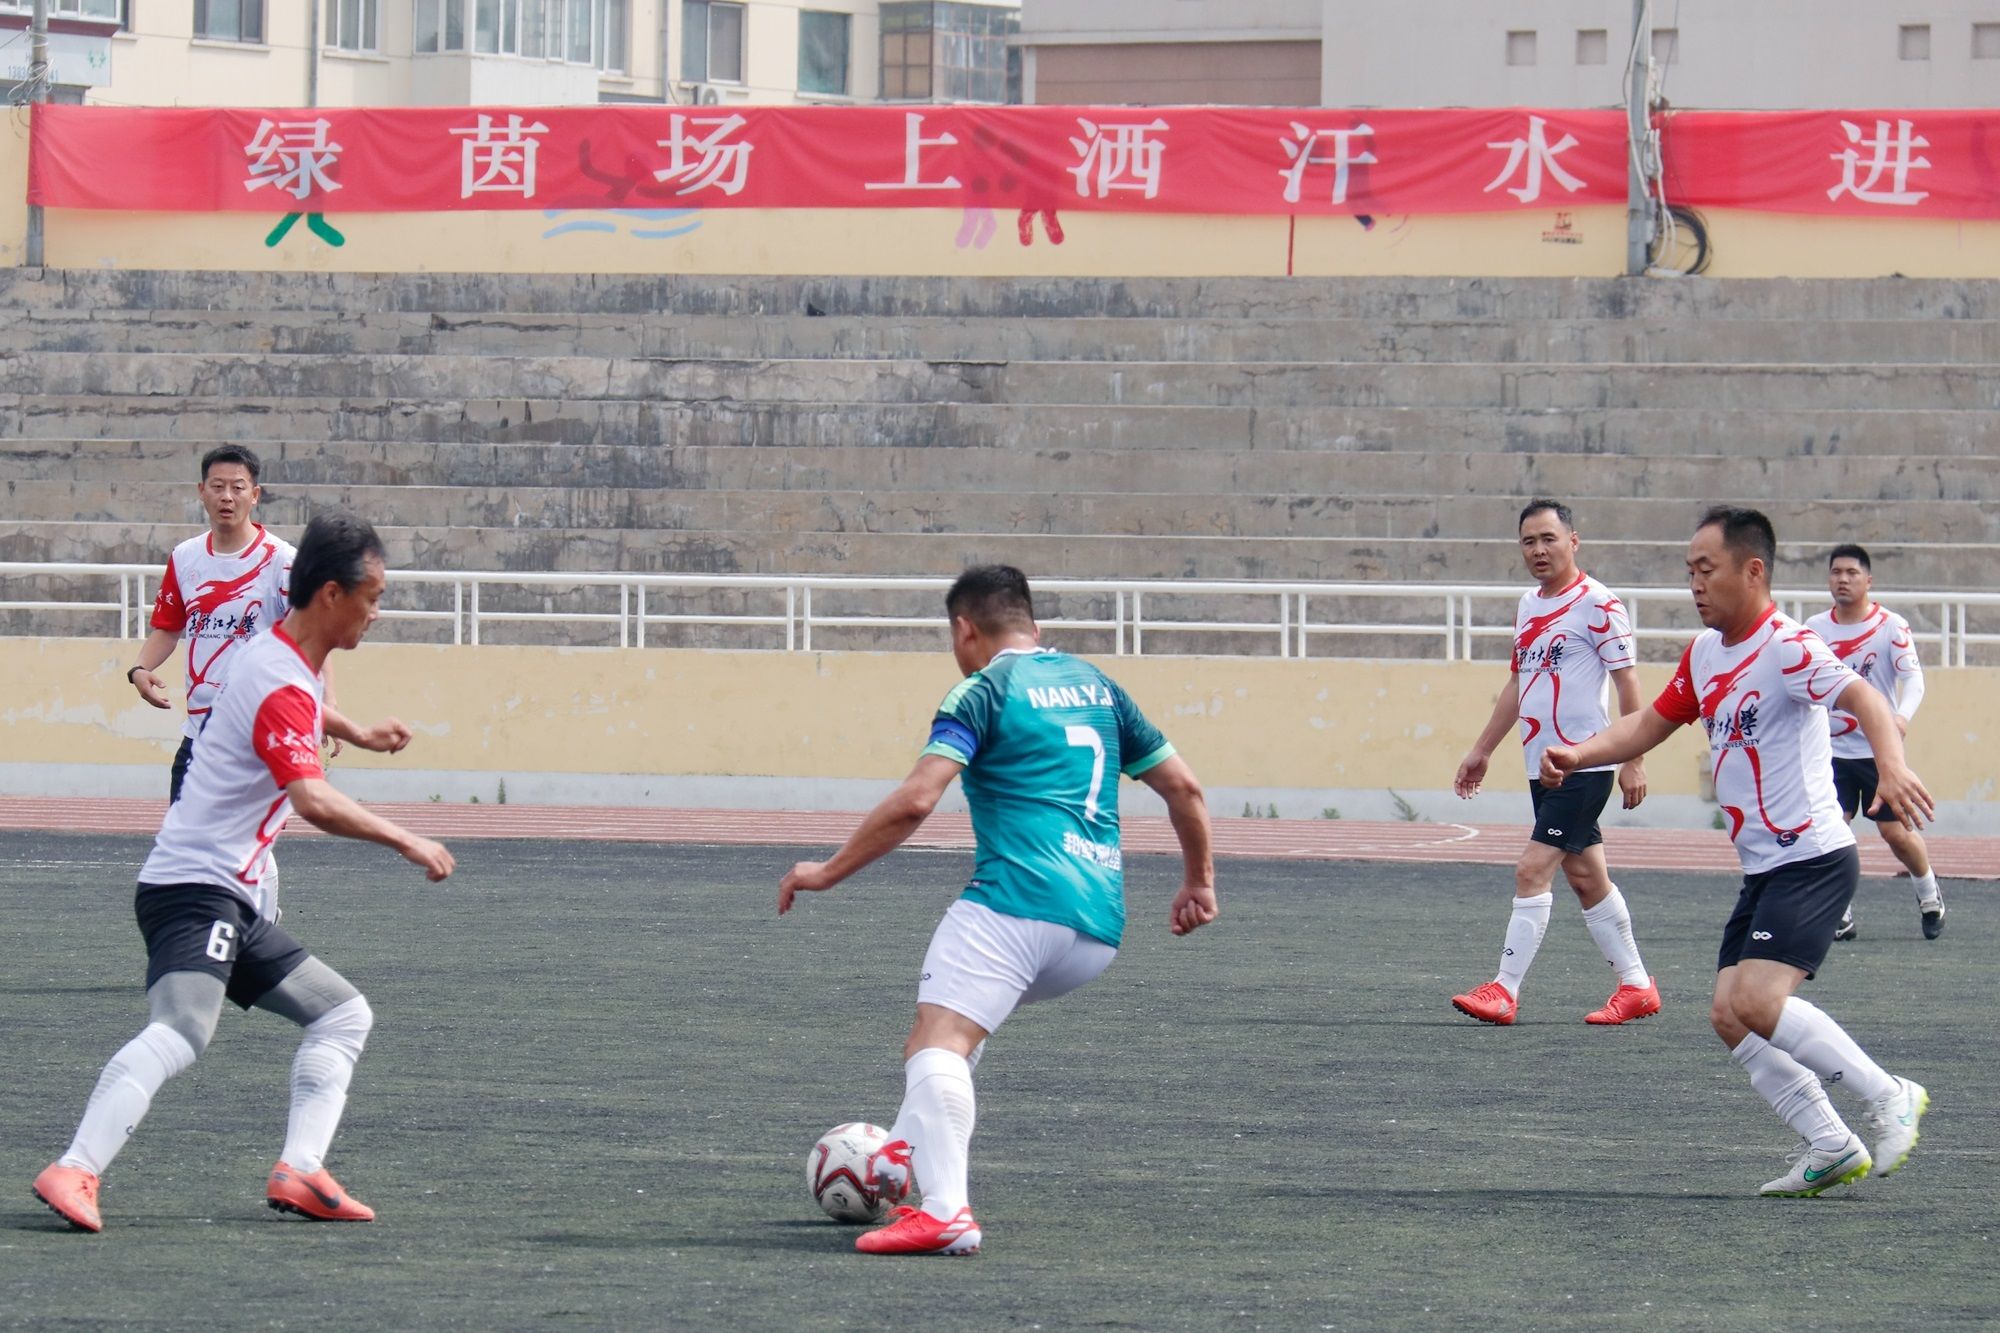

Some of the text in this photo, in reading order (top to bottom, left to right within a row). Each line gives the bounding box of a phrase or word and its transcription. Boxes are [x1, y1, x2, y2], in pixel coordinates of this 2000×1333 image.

[243, 112, 1932, 206] 绿茵场上洒汗水 进
[1064, 725, 1106, 820] 7
[206, 919, 234, 962] 6
